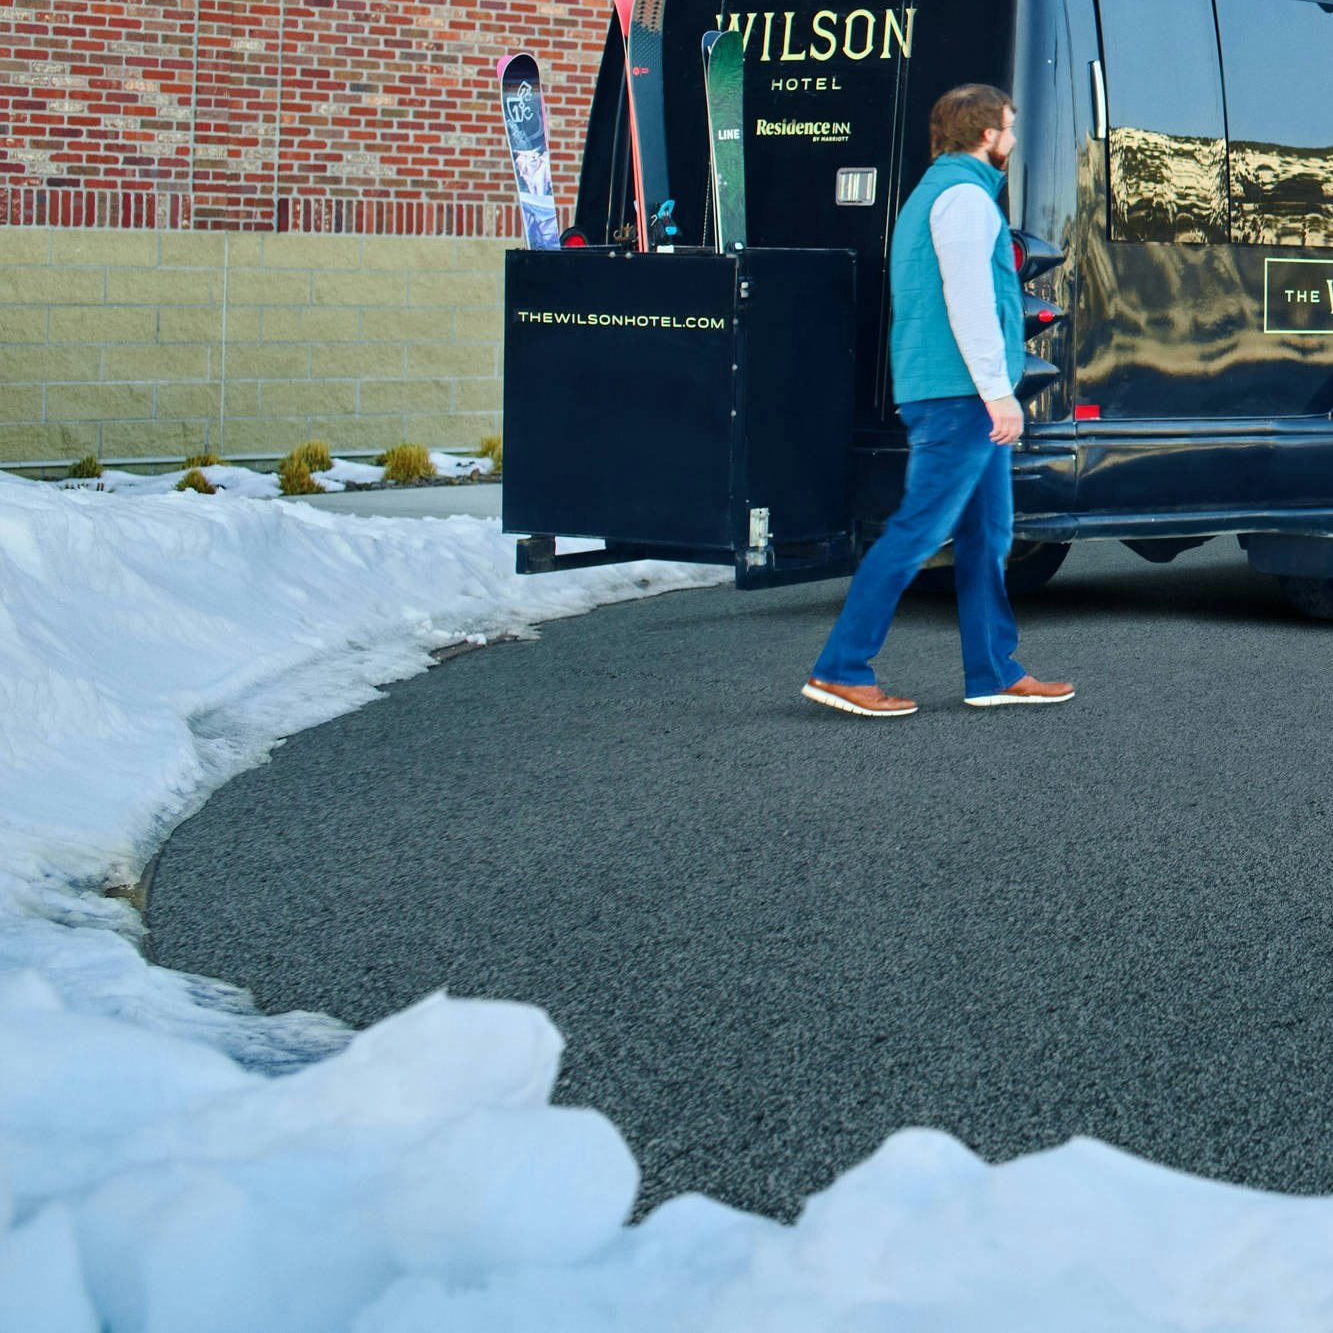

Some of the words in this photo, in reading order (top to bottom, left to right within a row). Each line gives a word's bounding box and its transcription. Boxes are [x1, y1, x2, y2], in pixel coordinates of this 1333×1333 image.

[771, 77, 842, 91] HOTEL
[756, 118, 831, 136] Residence
[718, 128, 740, 141] LINE
[1285, 289, 1321, 303] THE
[517, 311, 725, 330] THEWILSONHOTEL.COM
